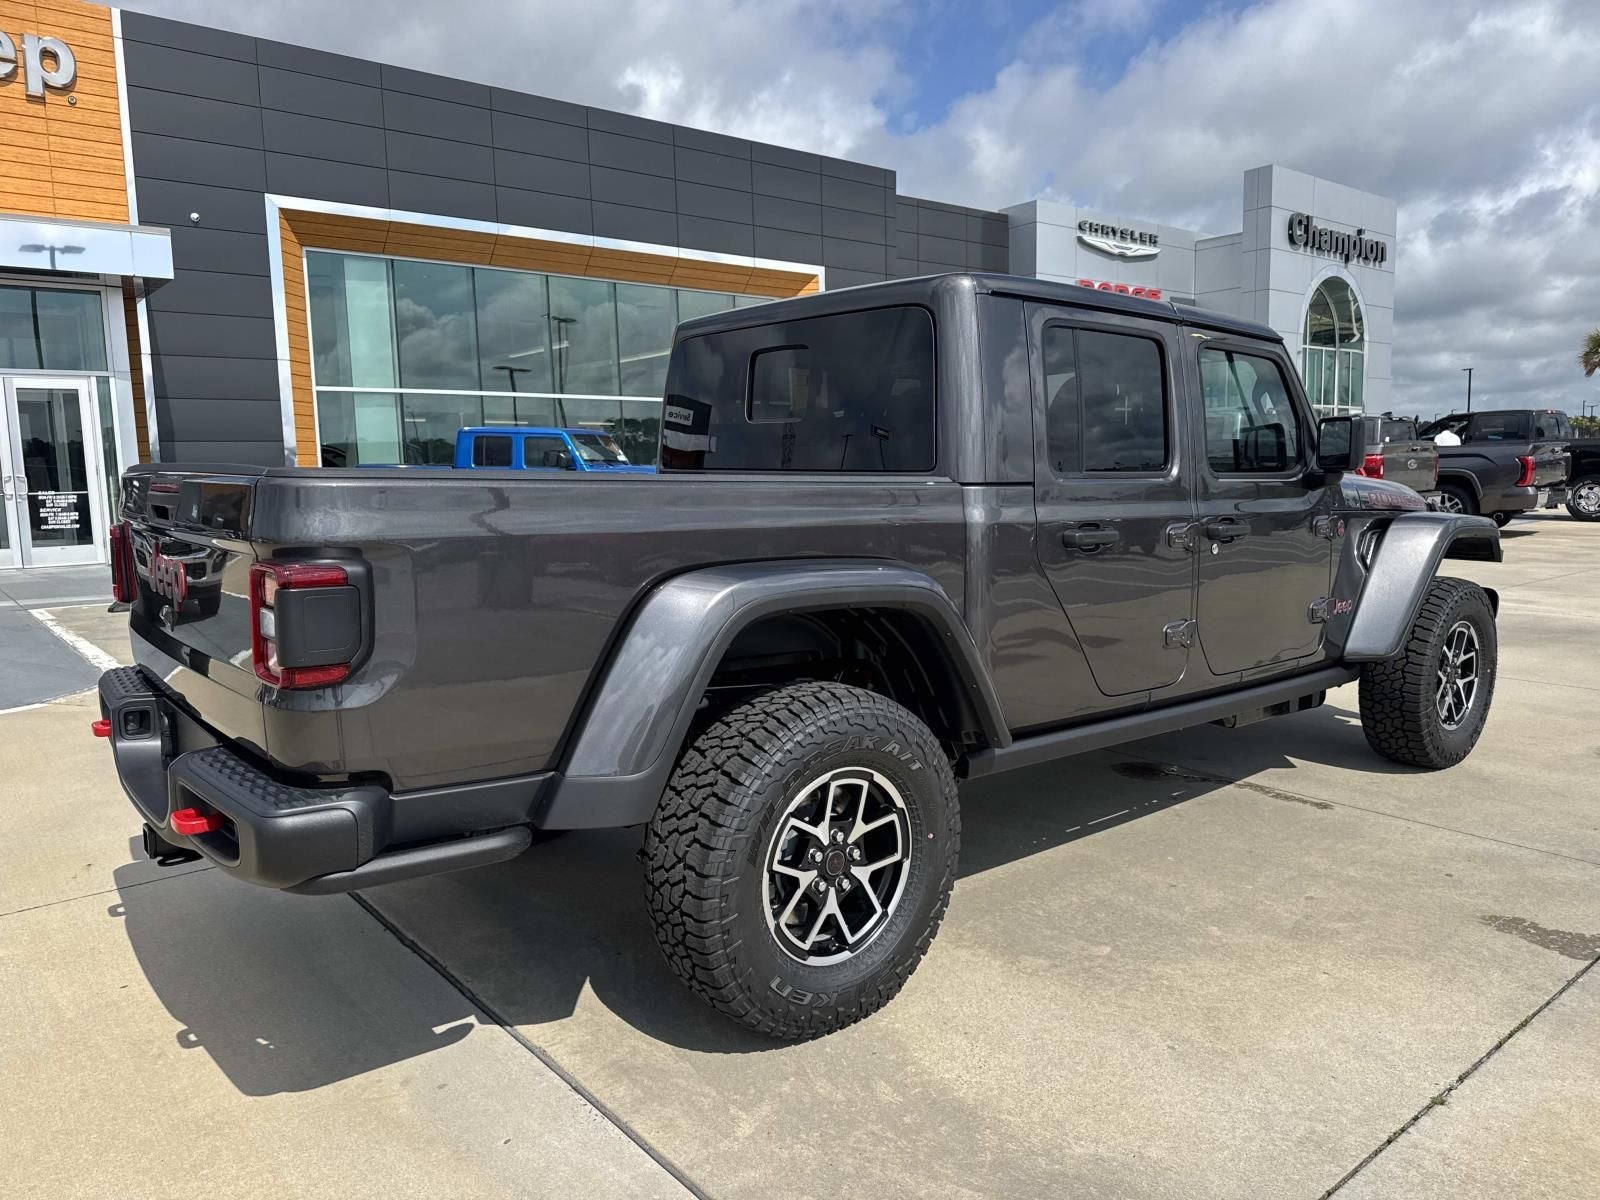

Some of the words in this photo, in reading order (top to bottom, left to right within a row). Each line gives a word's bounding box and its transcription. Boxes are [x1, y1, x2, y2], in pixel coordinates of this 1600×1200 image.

[1078, 220, 1159, 245] CHRYSLER
[1288, 212, 1387, 265] Champion
[149, 541, 187, 613] Jeep
[1333, 599, 1353, 615] Jeep
